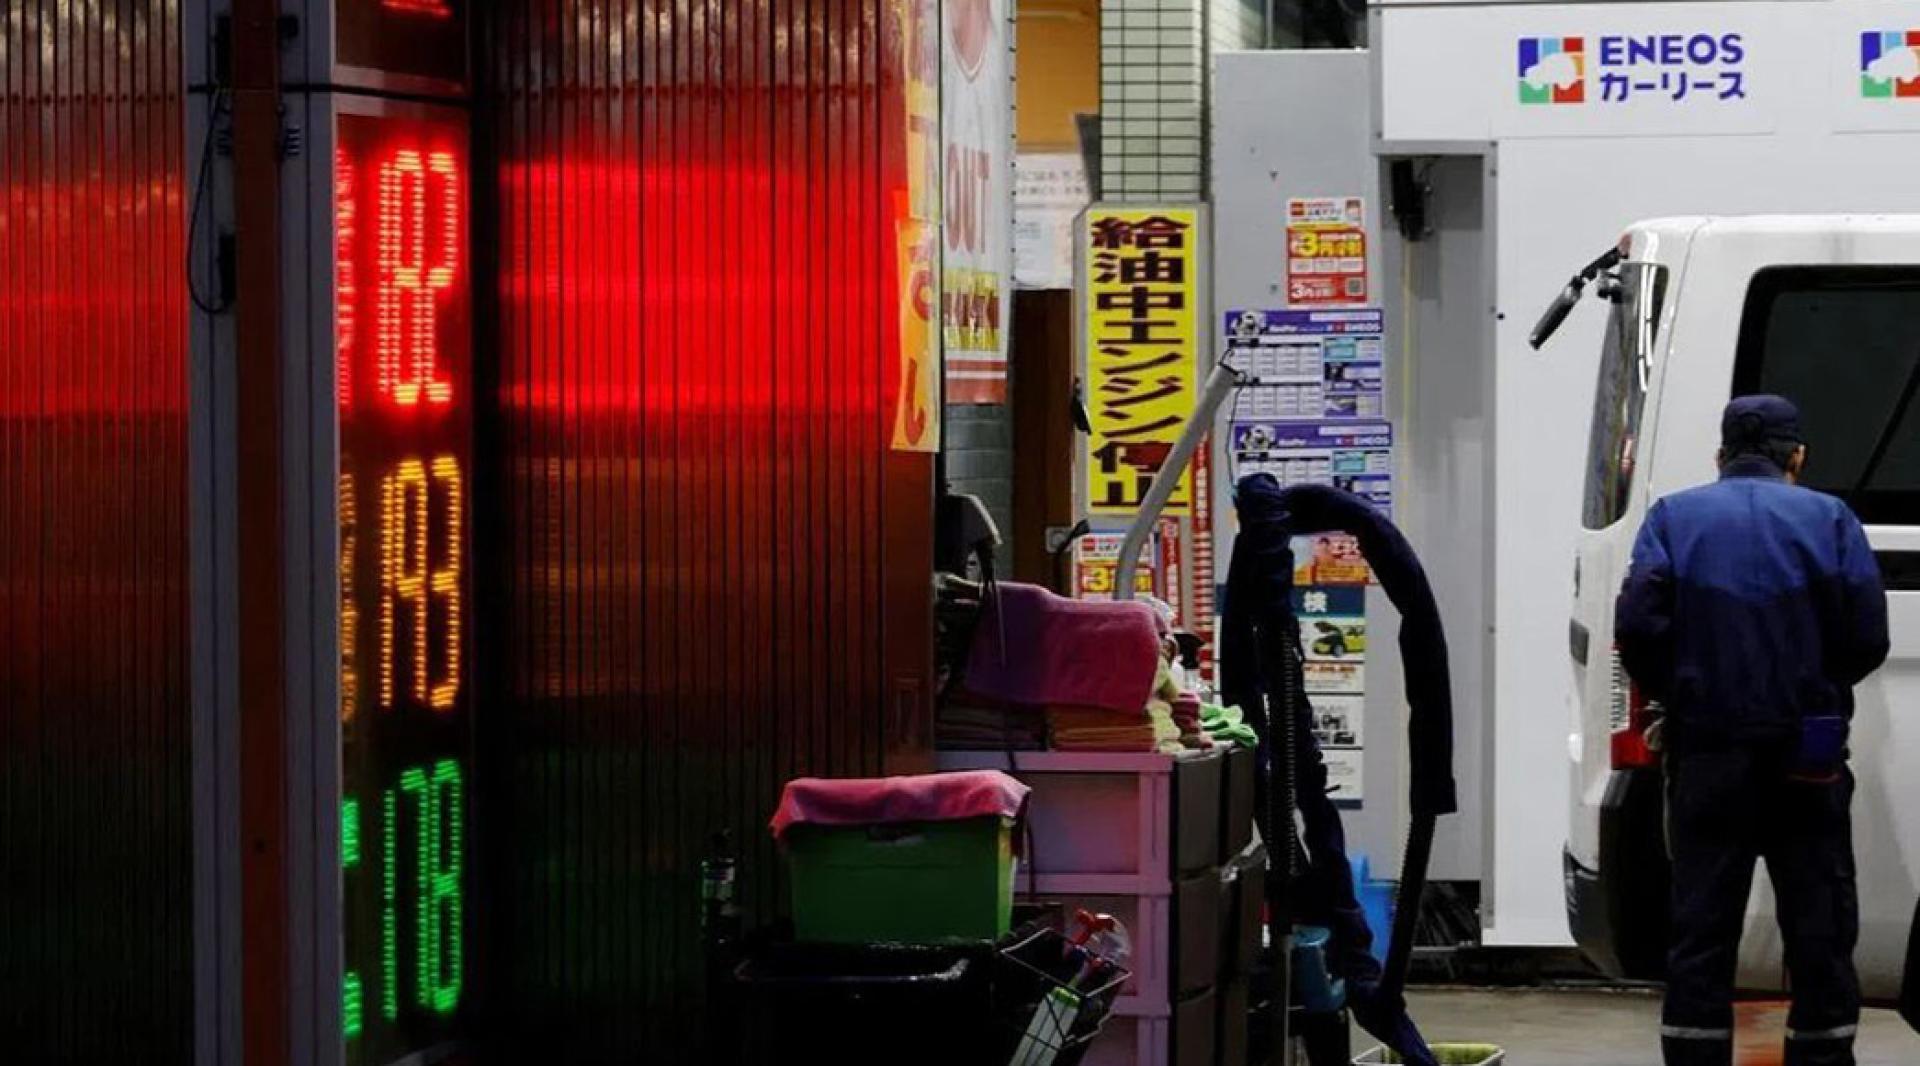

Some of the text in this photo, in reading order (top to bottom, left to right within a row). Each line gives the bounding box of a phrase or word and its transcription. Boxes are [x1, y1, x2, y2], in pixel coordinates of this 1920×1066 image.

[1600, 33, 1744, 65] ENEOS
[1600, 72, 1745, 102] カーリース
[378, 150, 459, 405] 182
[945, 142, 990, 254] OUT
[1091, 216, 1191, 507] 給油中エンジン停止
[380, 457, 462, 709] 193
[382, 759, 462, 1019] 178
